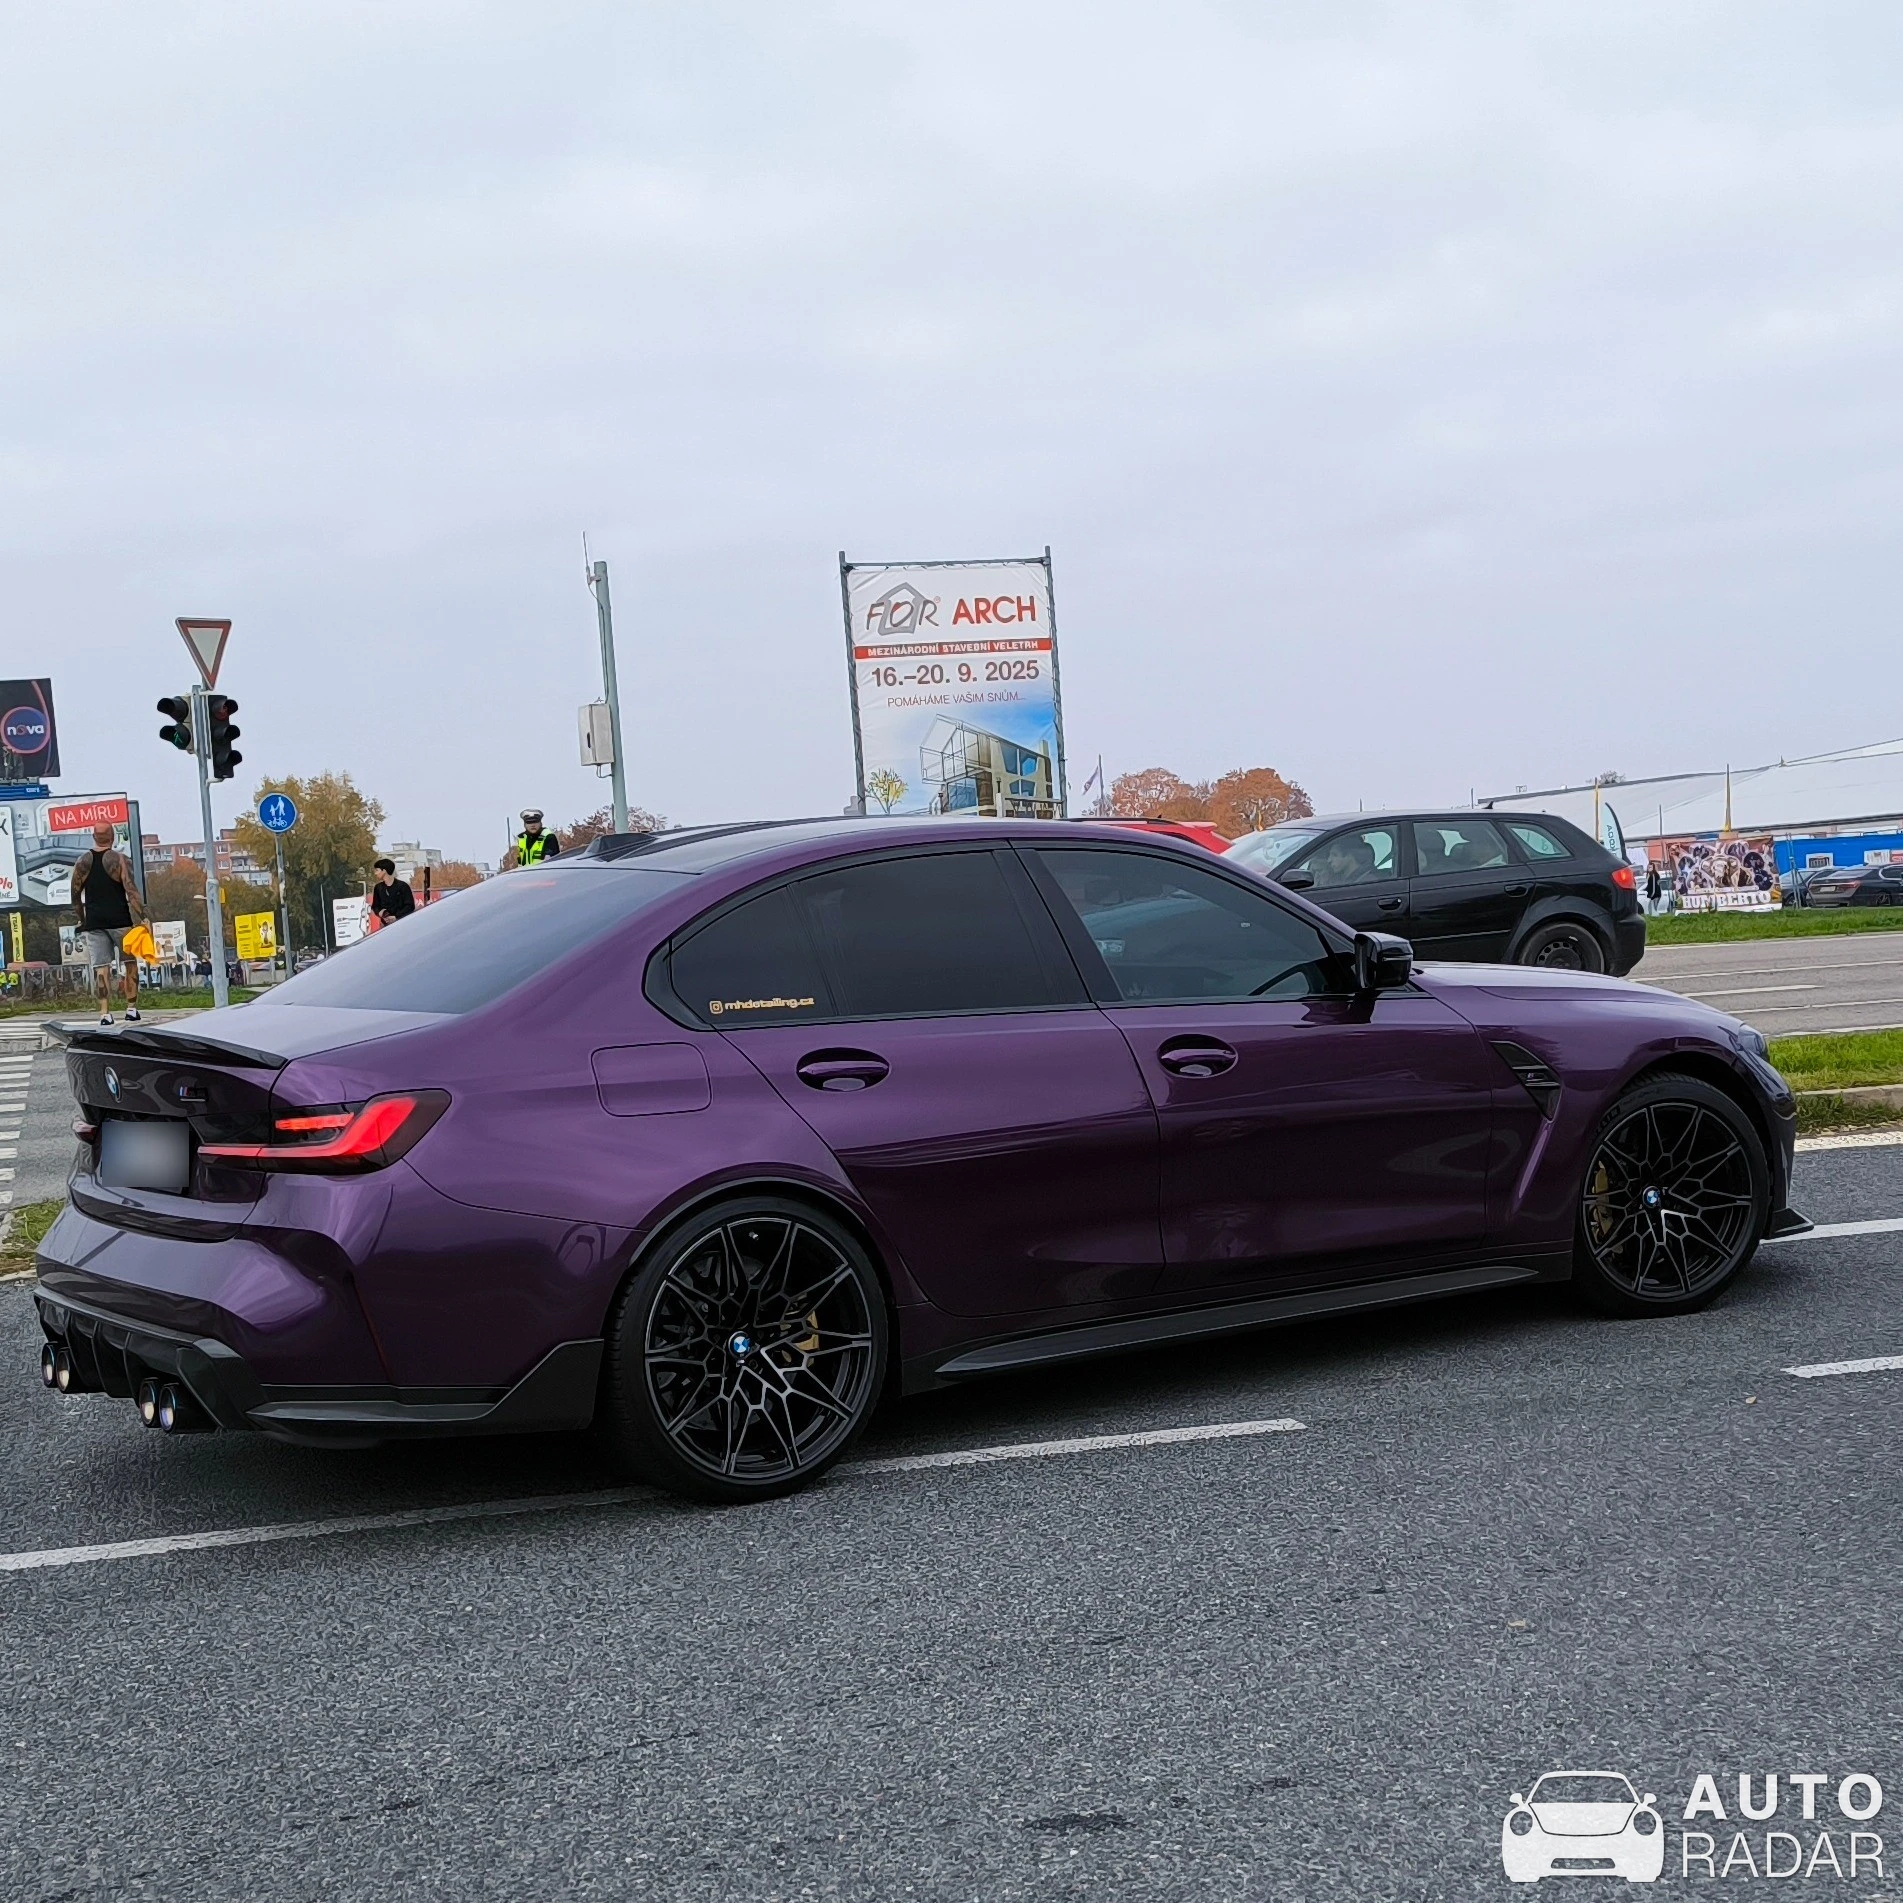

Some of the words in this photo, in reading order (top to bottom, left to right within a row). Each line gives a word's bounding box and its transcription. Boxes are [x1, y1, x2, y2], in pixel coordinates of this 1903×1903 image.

[952, 595, 1037, 625] ARCH
[867, 645, 939, 657] MEZINÁRODNÍ
[942, 642, 991, 654] STAVEBNÍ
[992, 640, 1039, 651] VELETRH
[957, 662, 978, 683] 9.
[985, 660, 1040, 682] 2025
[887, 692, 950, 707] POMÁHÁME
[952, 691, 984, 703] VAŠIM
[7, 724, 45, 736] nova
[54, 811, 78, 825] NA
[80, 804, 118, 822] MÍRU
[1682, 890, 1772, 910] HUMBERTO
